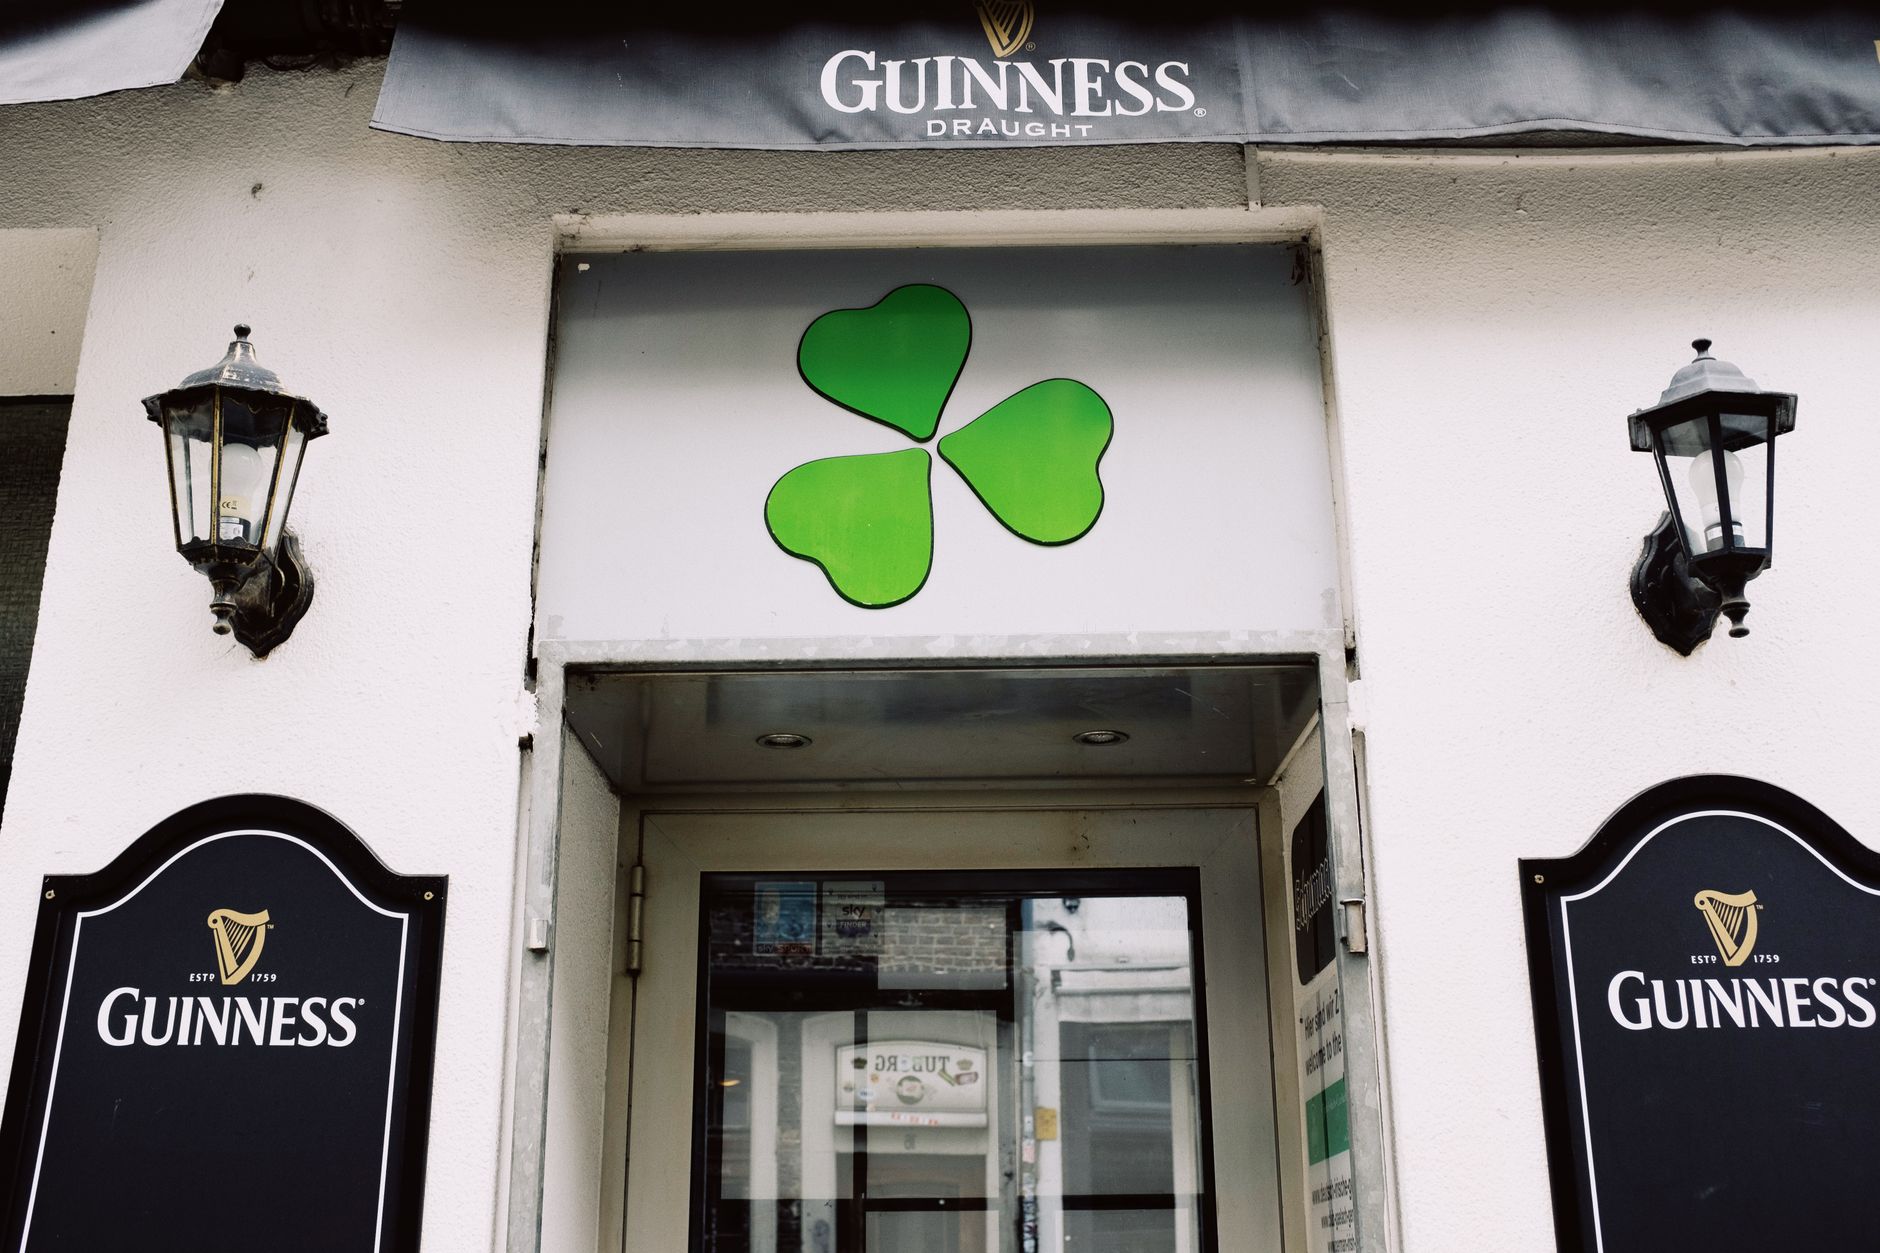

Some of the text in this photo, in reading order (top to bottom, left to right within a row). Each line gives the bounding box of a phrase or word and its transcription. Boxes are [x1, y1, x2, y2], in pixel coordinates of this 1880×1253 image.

[820, 49, 1196, 117] GUINNESS
[926, 117, 1093, 138] DRAUGHT
[251, 973, 277, 983] 1759
[1754, 954, 1780, 964] 1759
[97, 986, 357, 1048] GUINNESS
[1607, 970, 1877, 1031] GUINNESS
